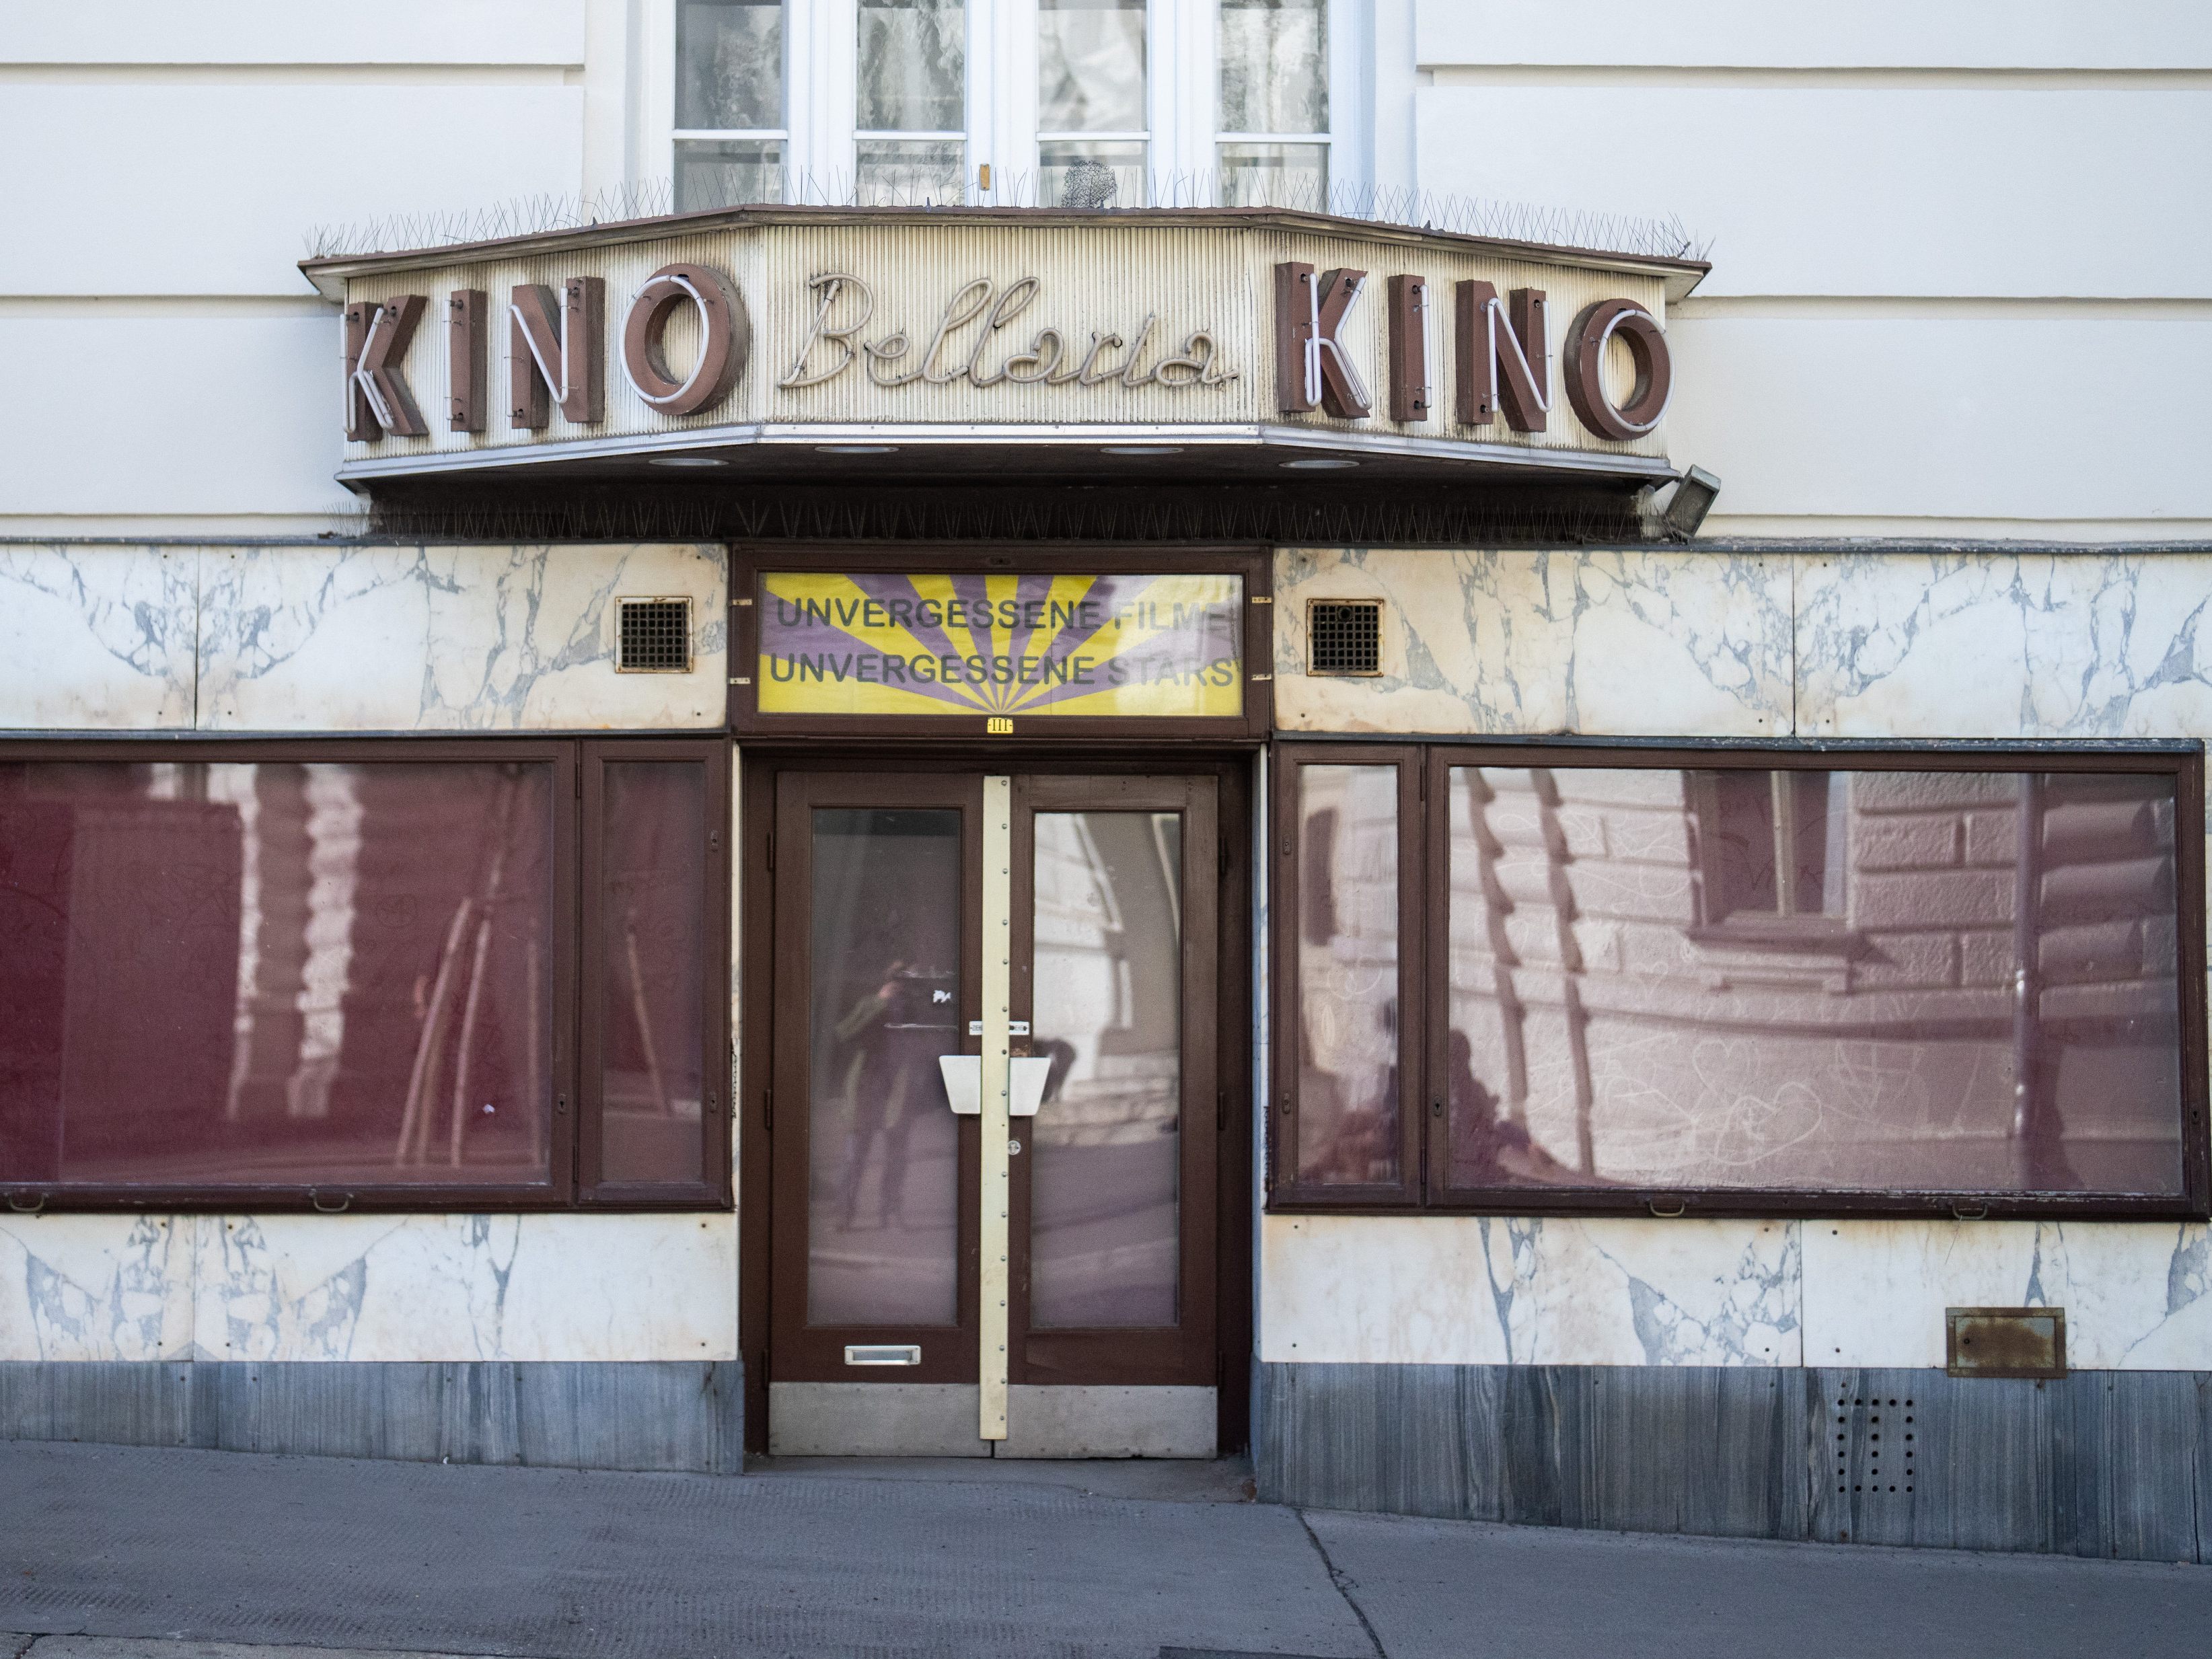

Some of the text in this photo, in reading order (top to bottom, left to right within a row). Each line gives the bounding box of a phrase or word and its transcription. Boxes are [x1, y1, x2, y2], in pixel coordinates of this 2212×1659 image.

[340, 263, 749, 441] KINO
[778, 272, 1239, 388] Bellaria
[1275, 261, 1675, 441] KINO
[770, 653, 1234, 688] UNVERGESSENE STARS
[777, 598, 1229, 631] UNVERGESSENE FILME
